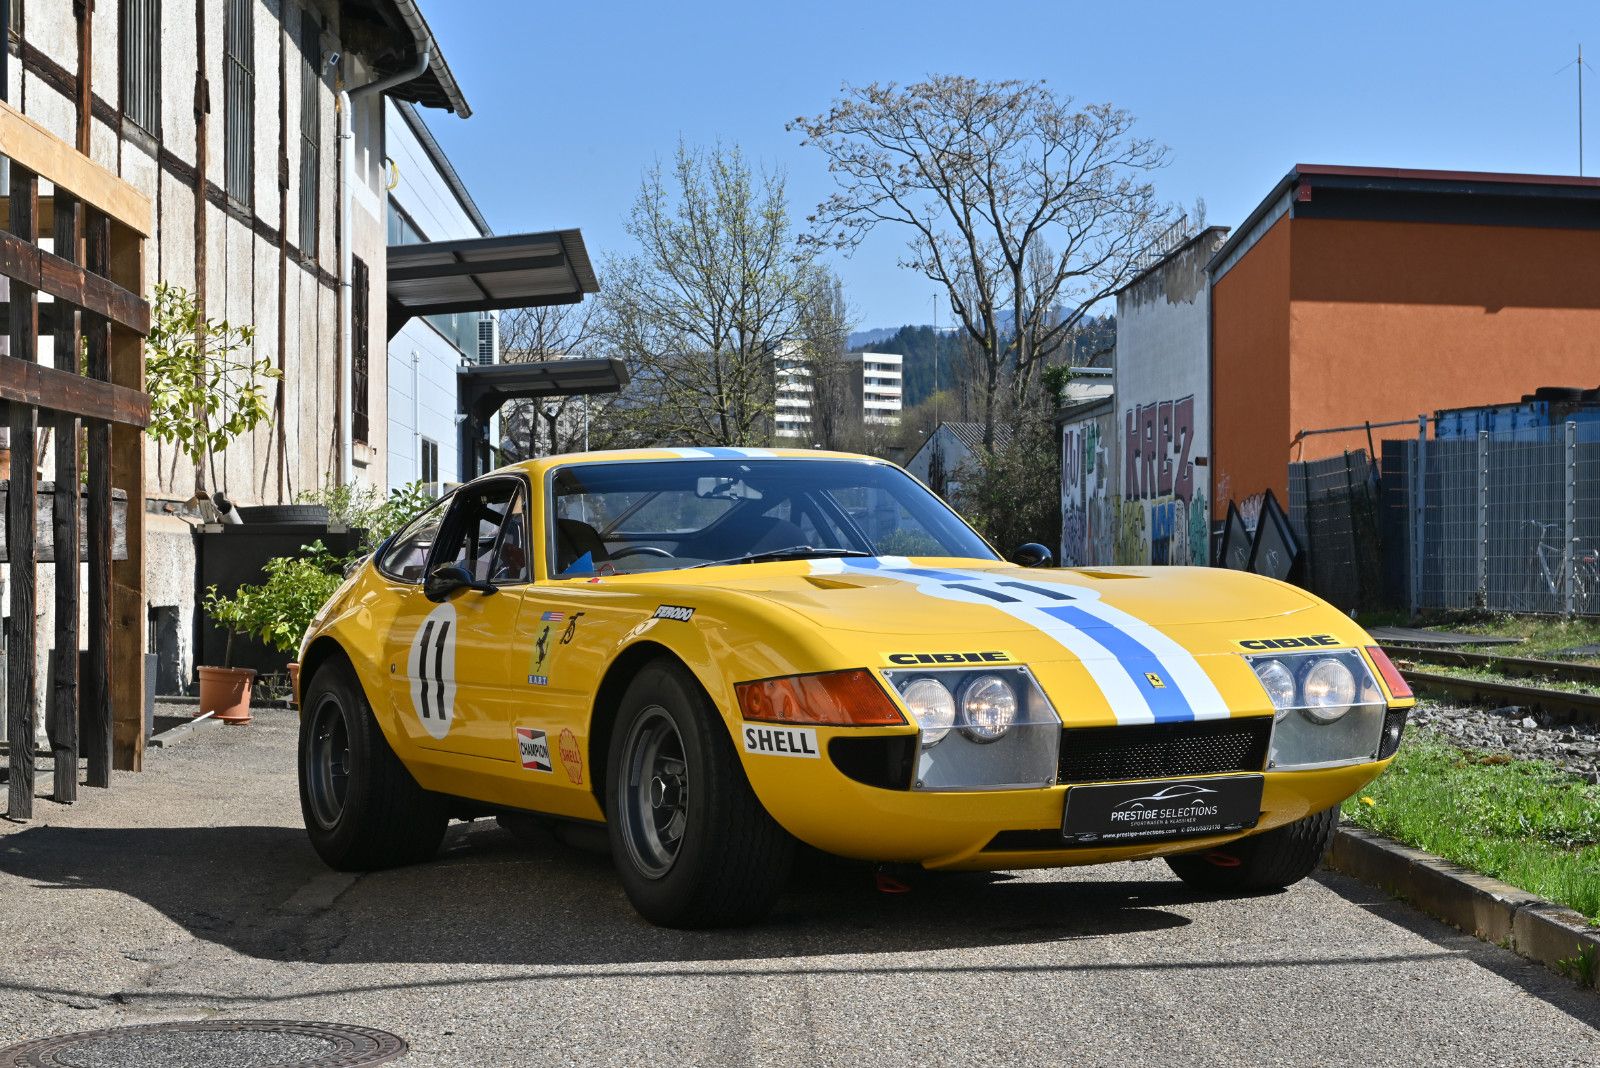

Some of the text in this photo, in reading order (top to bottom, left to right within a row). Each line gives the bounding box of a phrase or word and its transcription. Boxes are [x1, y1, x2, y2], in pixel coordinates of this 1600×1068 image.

[940, 581, 1078, 603] 11
[654, 605, 693, 621] FERODO
[419, 620, 451, 720] 11
[745, 728, 815, 754] SHELL
[520, 742, 549, 759] CHAMPION
[560, 748, 580, 764] SHELL
[1110, 805, 1218, 822] PRESTIGE SELECTIONS
[1102, 827, 1177, 839] www.prestige-selections.com
